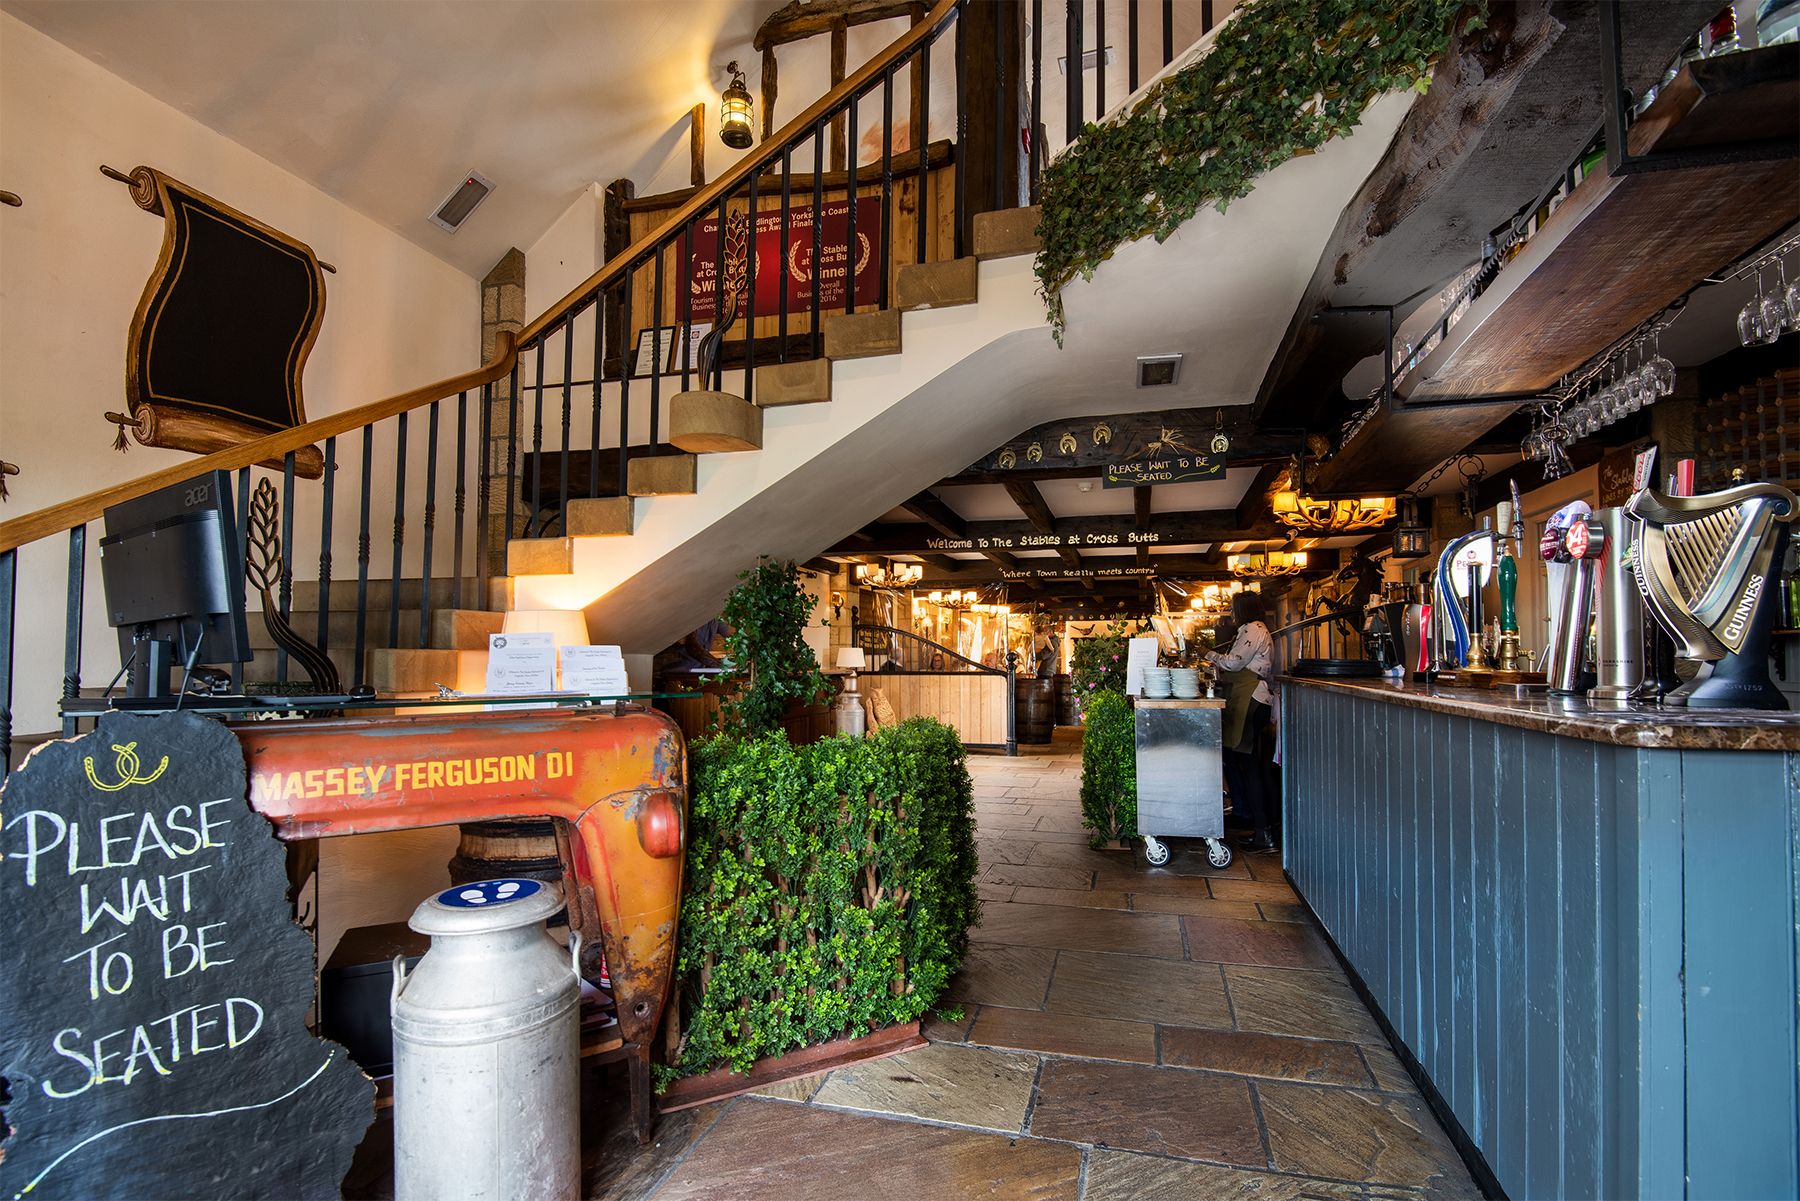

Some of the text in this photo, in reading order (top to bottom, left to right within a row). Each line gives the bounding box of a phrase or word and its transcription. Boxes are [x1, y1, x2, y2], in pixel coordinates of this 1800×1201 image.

[696, 270, 704, 278] at
[701, 261, 715, 269] The
[833, 286, 844, 294] the
[1109, 456, 1210, 475] PLEASE WAIT TO BE
[1136, 472, 1173, 482] SEATED
[185, 482, 214, 507] acer
[926, 532, 1159, 549] Welcome To The Stables at Cross Butts
[1037, 569, 1057, 577] Town
[1098, 568, 1122, 576] meets
[1632, 539, 1648, 596] GUINNESS
[1724, 574, 1764, 641] GUINNESS
[251, 765, 387, 801] MASSEY
[395, 754, 535, 791] FERGUSON
[5, 798, 235, 886] PLEASE
[80, 865, 212, 934] WAIT
[63, 922, 235, 1000] TO BE
[42, 997, 265, 1099] SEATED
